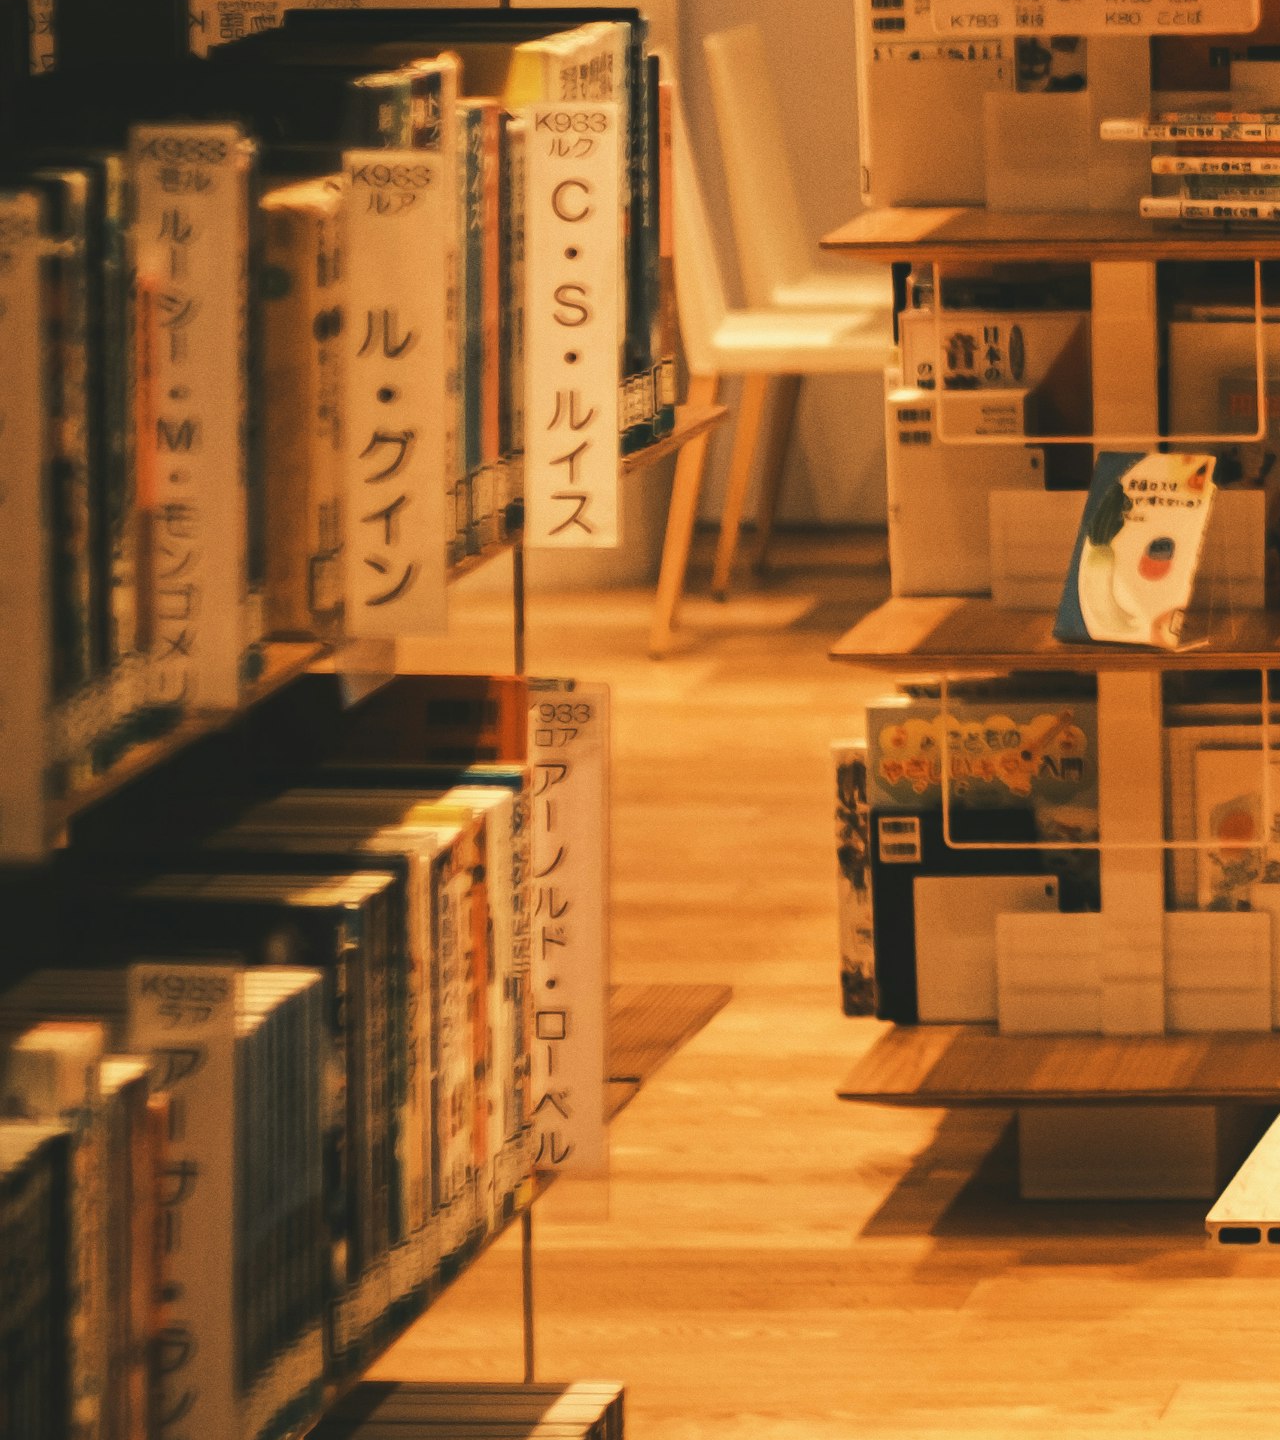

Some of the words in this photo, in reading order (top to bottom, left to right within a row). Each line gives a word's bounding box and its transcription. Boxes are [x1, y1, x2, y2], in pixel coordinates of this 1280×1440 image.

[534, 111, 608, 133] K933
[547, 178, 597, 539] C・S・ルイス
